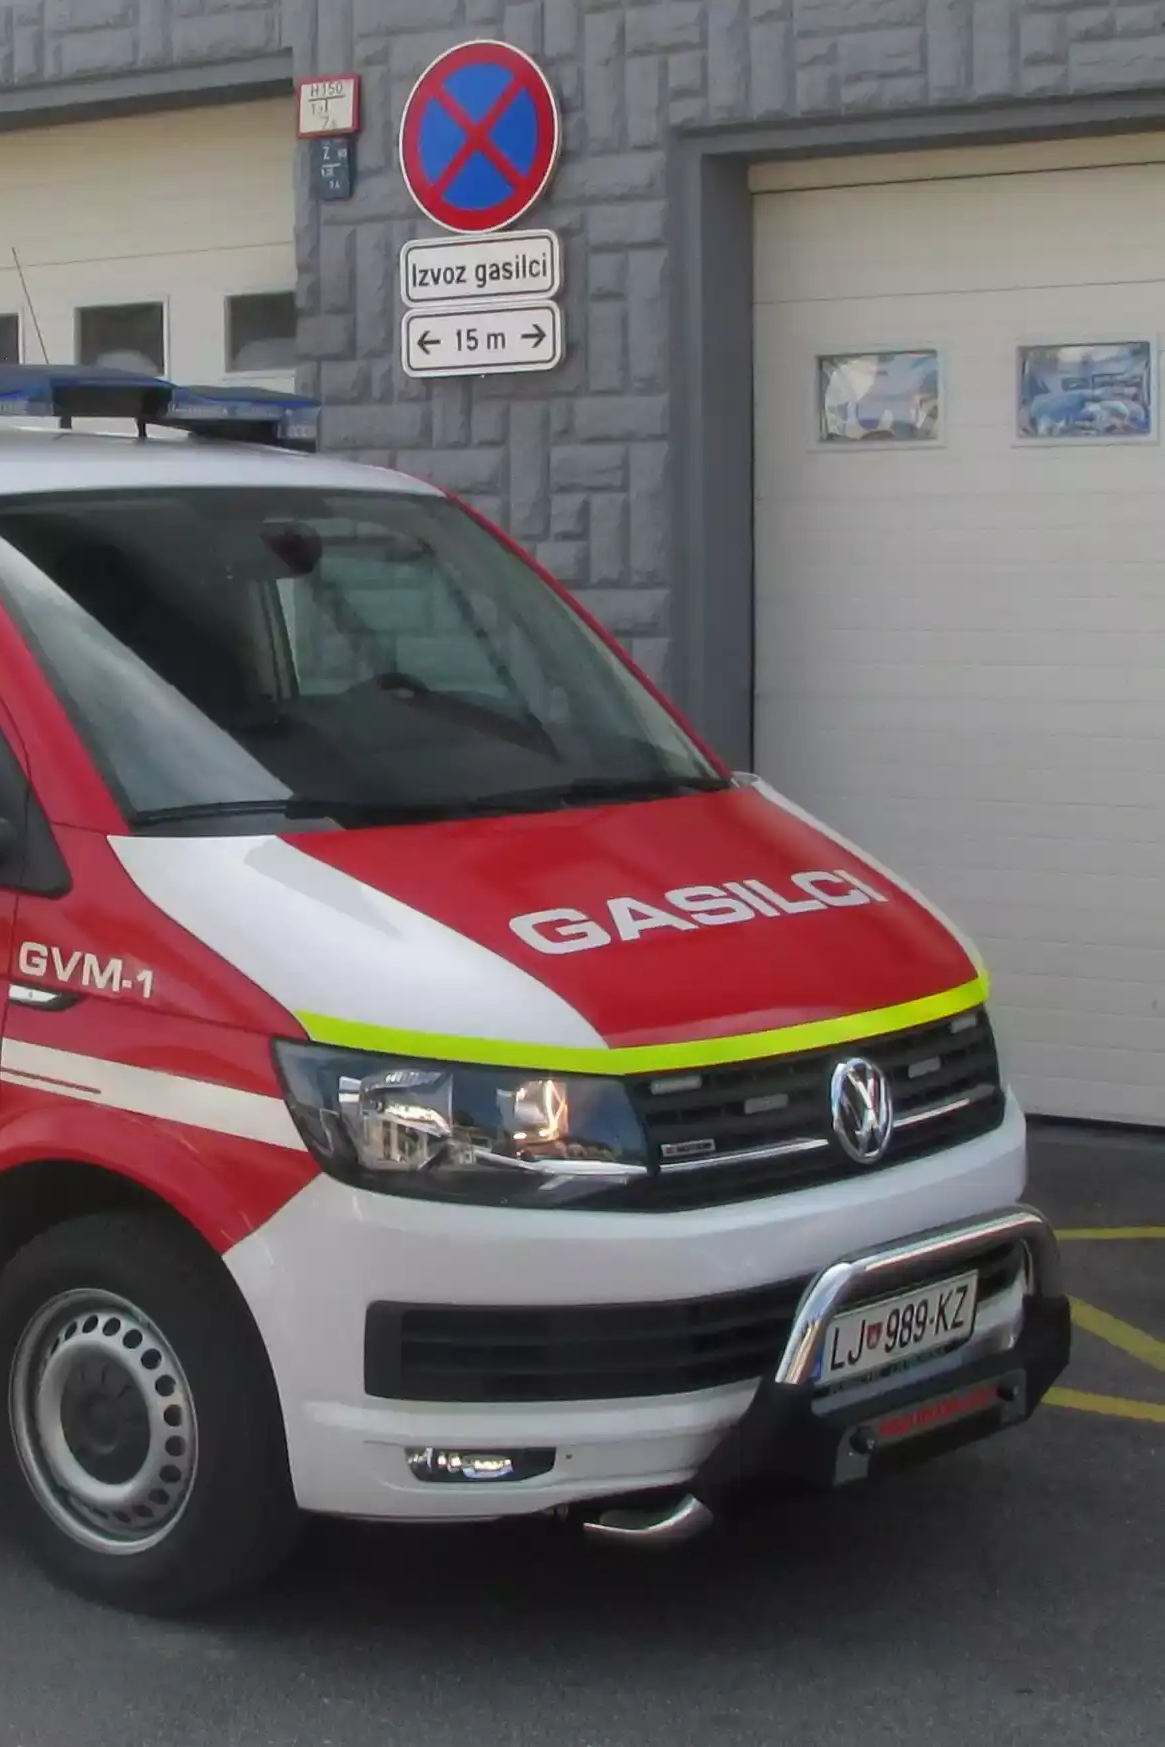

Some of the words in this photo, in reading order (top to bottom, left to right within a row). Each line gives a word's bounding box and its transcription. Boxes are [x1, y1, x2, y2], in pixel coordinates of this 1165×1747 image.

[412, 263, 467, 287] Izvoz
[475, 252, 547, 288] gasilci
[455, 329, 479, 351] 15
[487, 332, 506, 350] m
[508, 869, 889, 955] GASILCI
[19, 941, 153, 999] GVM-1
[830, 1319, 867, 1371] LJ
[885, 1284, 969, 1354] 989-KZ
